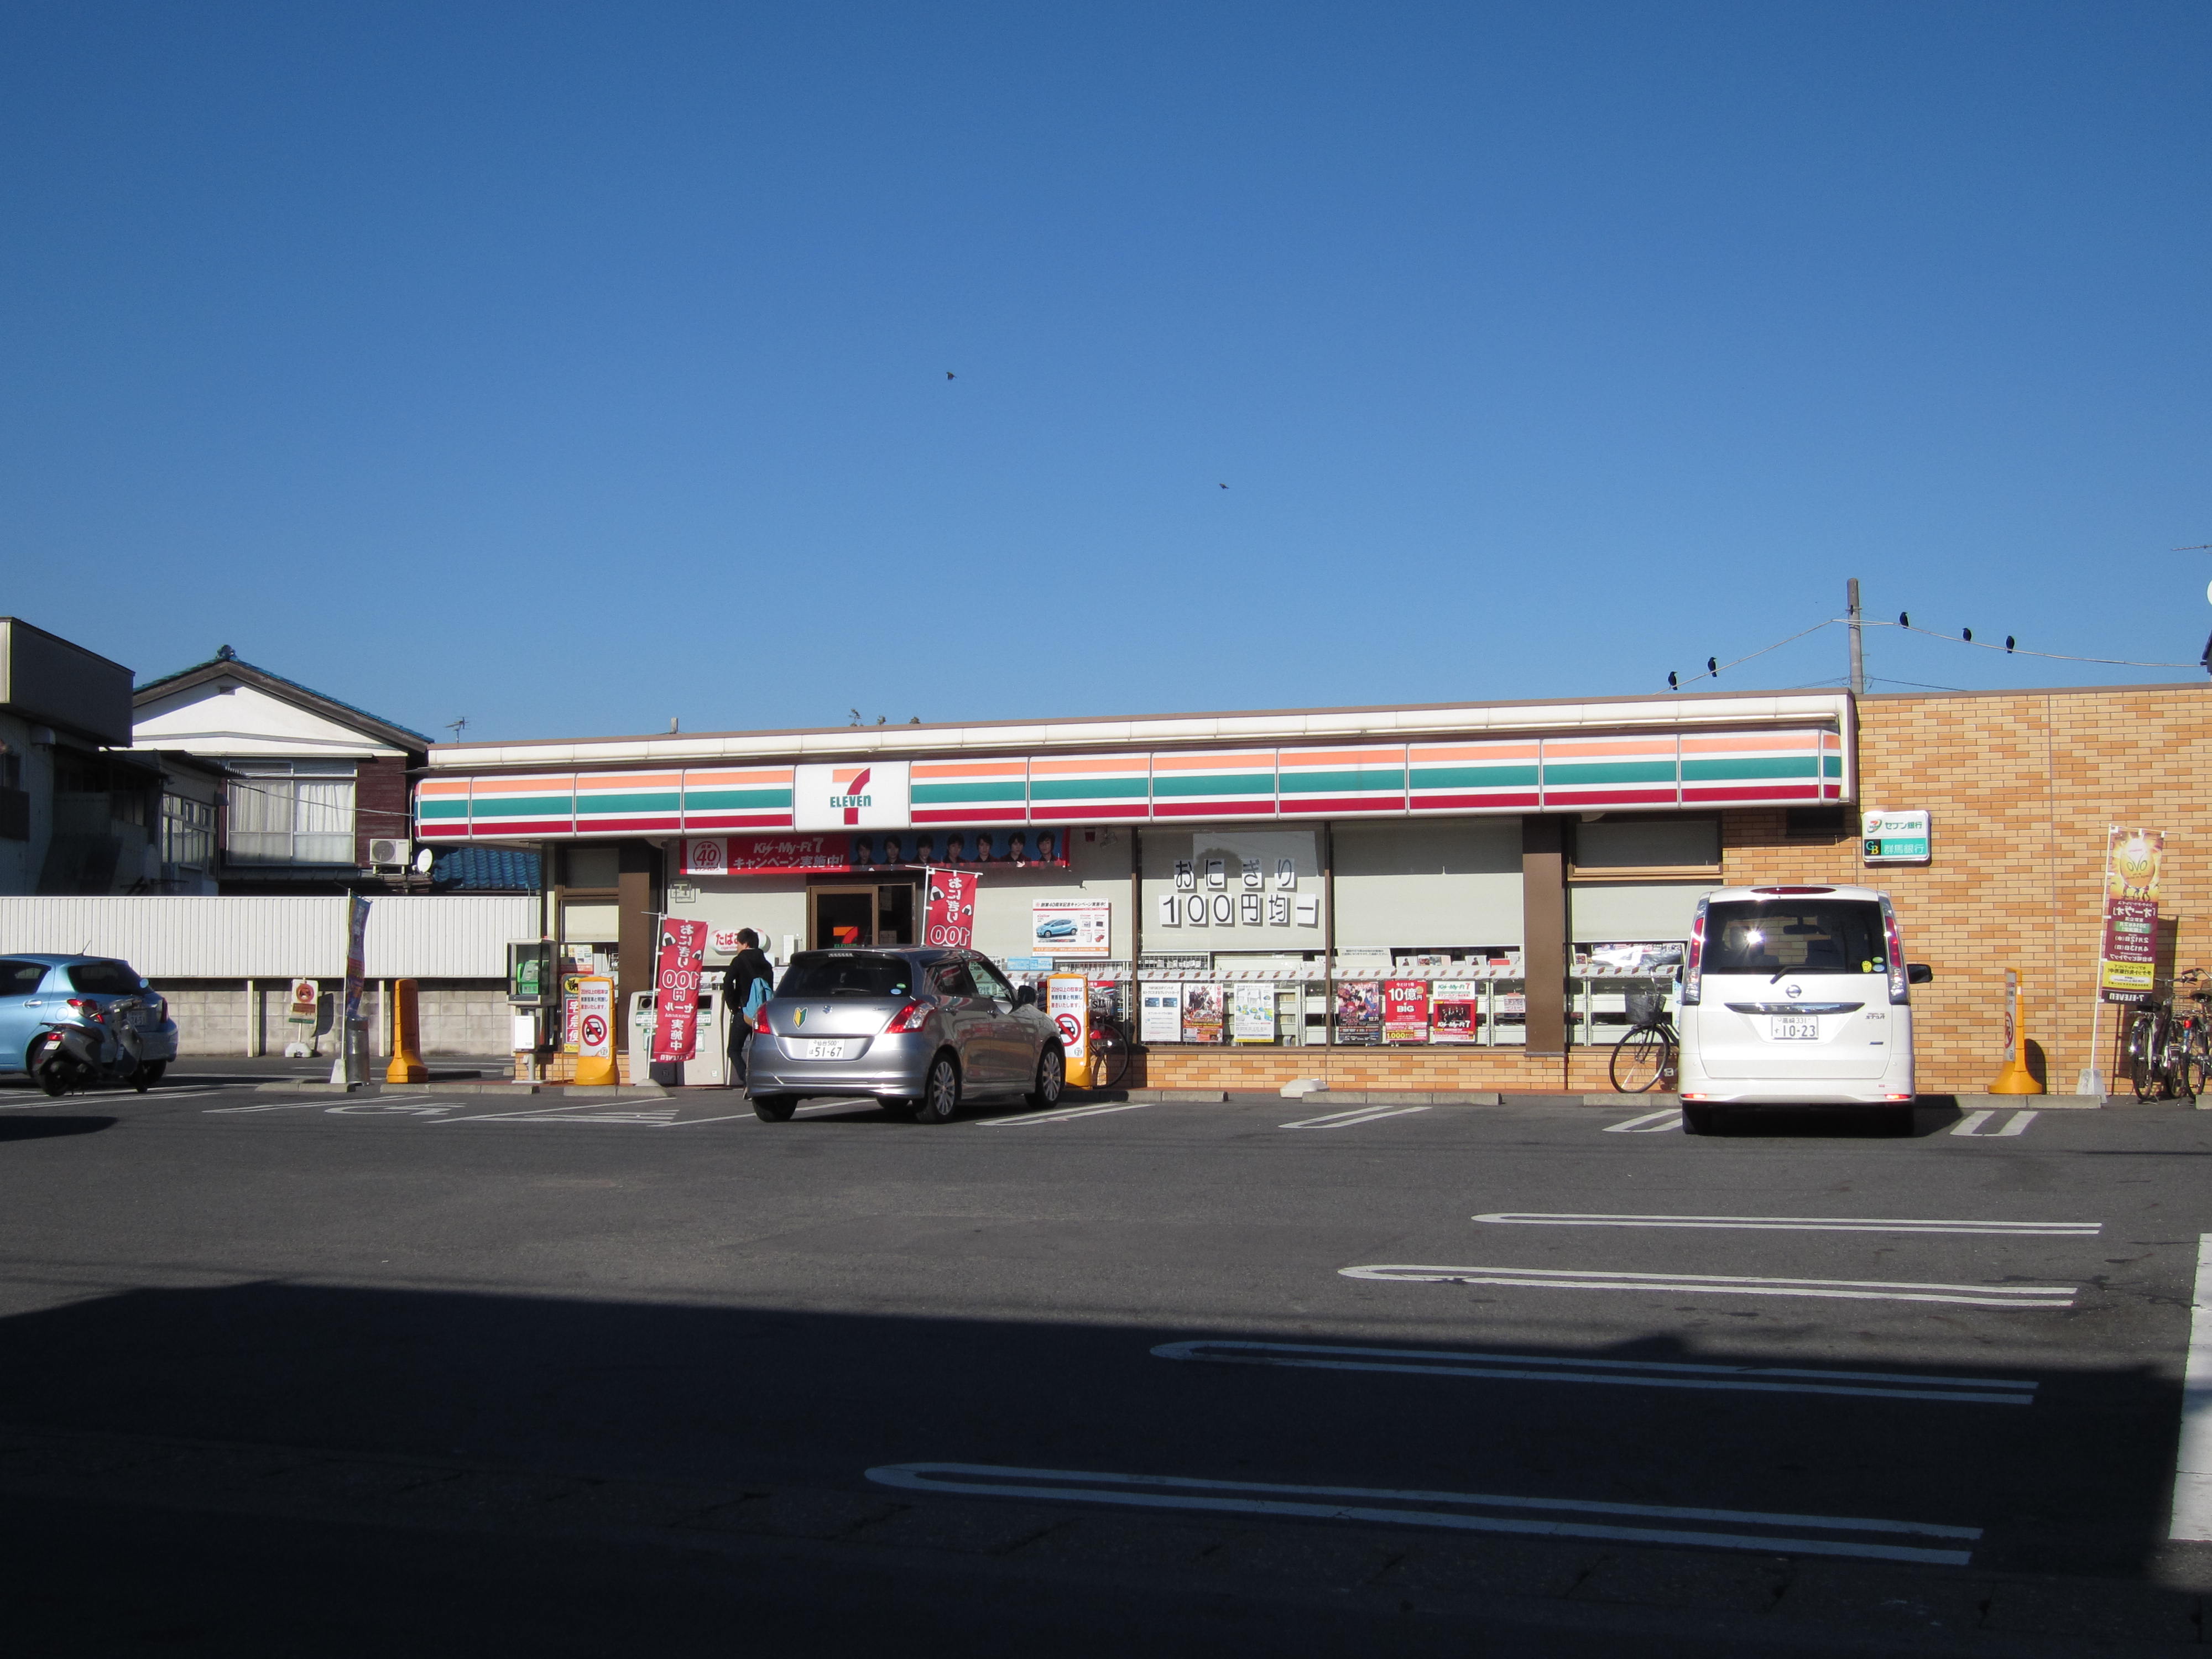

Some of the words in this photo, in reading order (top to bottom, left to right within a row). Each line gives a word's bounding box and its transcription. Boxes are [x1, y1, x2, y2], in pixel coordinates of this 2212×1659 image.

[1885, 821, 1922, 830] セブン銀行
[1884, 843, 1924, 854] 群馬銀行
[696, 849, 716, 864] 40
[1176, 859, 1292, 888] おにぎり
[1163, 894, 1314, 922] 100円均一
[1783, 1025, 1815, 1037] 10-23
[815, 1047, 842, 1057] 51-67
